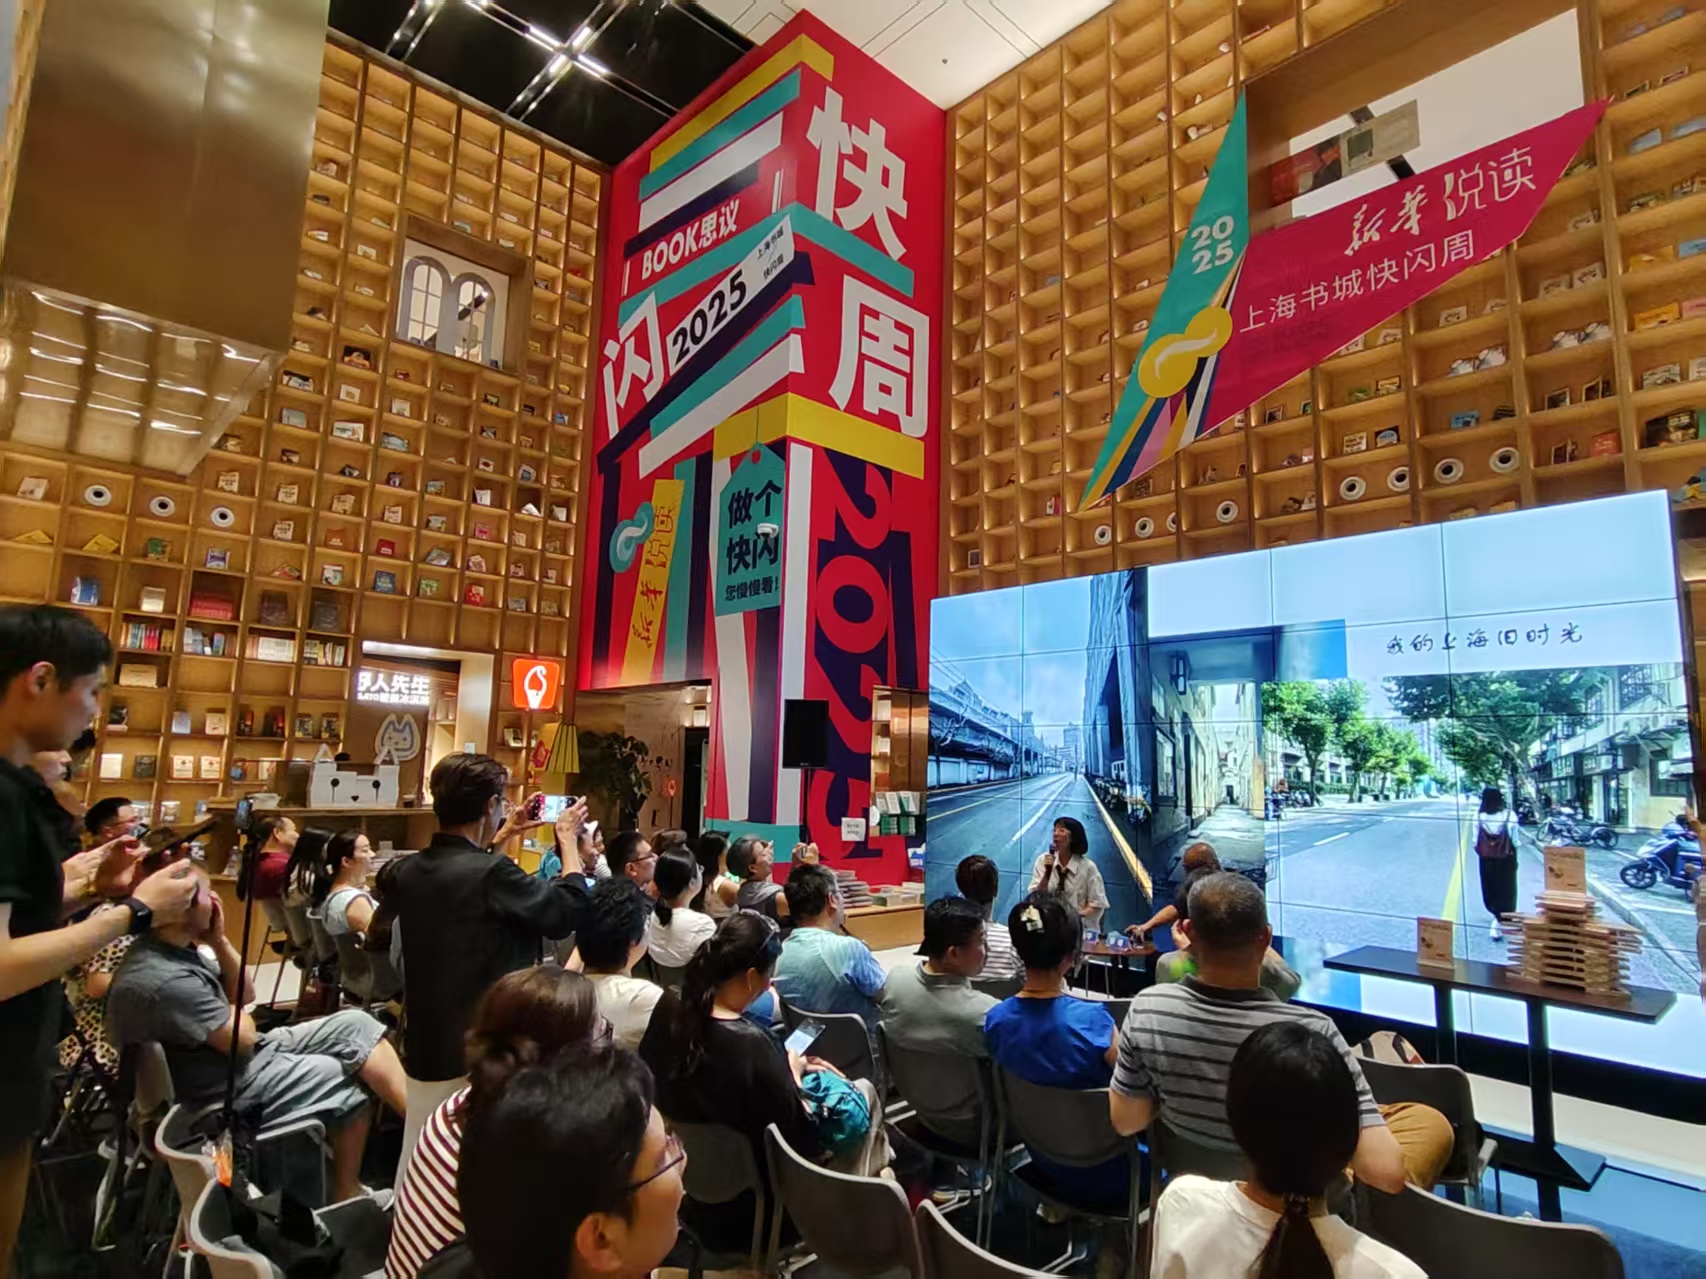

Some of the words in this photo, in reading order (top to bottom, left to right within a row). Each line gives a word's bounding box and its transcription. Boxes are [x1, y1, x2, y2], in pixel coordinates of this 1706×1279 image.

[806, 86, 908, 262] 快
[641, 199, 740, 281] BOOK思议
[1190, 214, 1234, 251] 20
[1192, 239, 1234, 276] 25
[671, 269, 747, 366] 2025
[1239, 229, 1474, 334] 上海书城快闪周
[602, 291, 664, 440] 闪
[829, 274, 929, 438] 周
[728, 479, 782, 529] 做个
[726, 532, 780, 576] 快闪
[1386, 622, 1584, 655] 我的上海旧时光
